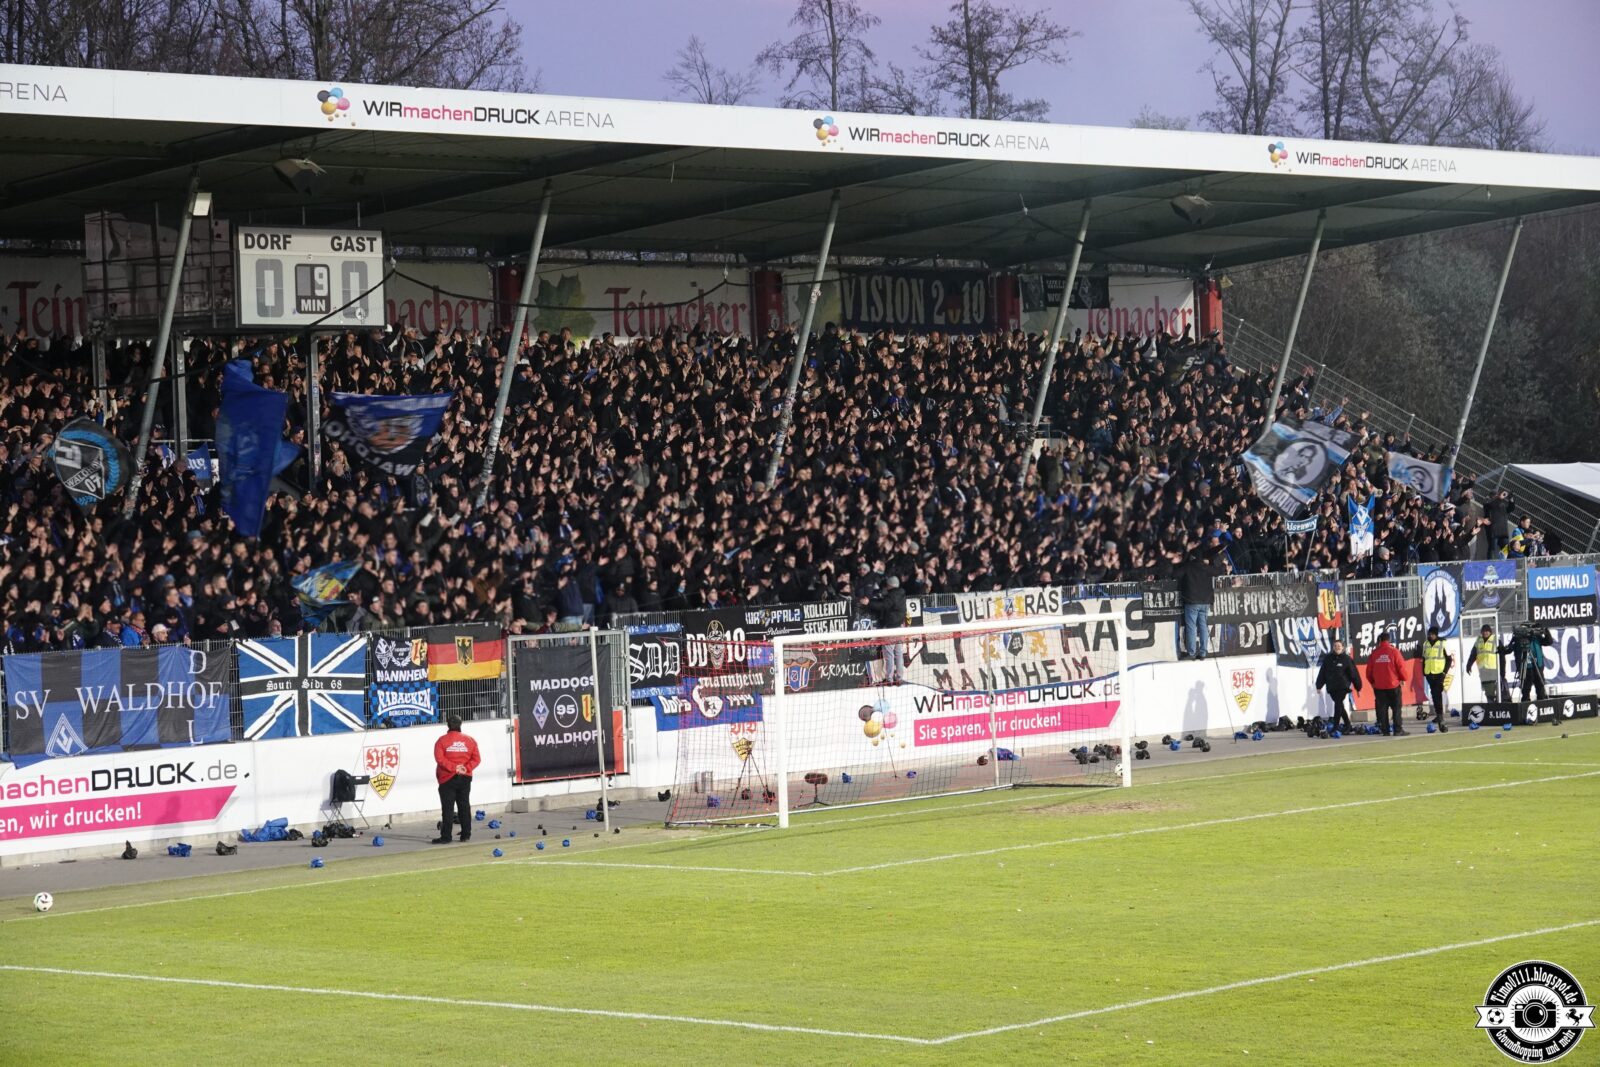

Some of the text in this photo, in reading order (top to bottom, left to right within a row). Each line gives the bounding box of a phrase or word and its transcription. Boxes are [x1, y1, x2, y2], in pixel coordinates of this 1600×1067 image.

[0, 82, 68, 102] RENA
[363, 99, 615, 129] WIRmachenDRUCK ARENA
[848, 126, 1050, 151] WIRmachenDRUCK ARENA
[1296, 151, 1457, 173] WIRmachenDRUCK ARENA
[244, 233, 377, 253] DORF GAST
[301, 299, 326, 312] MIN
[841, 273, 925, 325] VISION
[1536, 573, 1589, 591] ODENWALD
[803, 600, 848, 619] KOLLEKTIV
[1533, 602, 1593, 620] BARACKLER
[376, 668, 429, 682] MANNHEIM
[933, 655, 1094, 690] MANNHEIM
[330, 679, 343, 690] 68
[530, 677, 596, 691] MADDOGS
[14, 681, 223, 720] SV WALDHOF
[377, 688, 431, 711] RABAUKEN
[1580, 702, 1591, 711] LIGA
[556, 704, 576, 715] 95
[1495, 711, 1511, 719] LIGA
[1544, 706, 1555, 715] LIGA
[919, 724, 938, 741] Sie
[941, 721, 986, 743] sparen,
[1010, 711, 1061, 732] drucken!
[533, 730, 600, 746] WALDHOF
[0, 759, 238, 800] achenDRUCK.de
[30, 810, 59, 830] wir
[63, 801, 142, 827] drucken!
